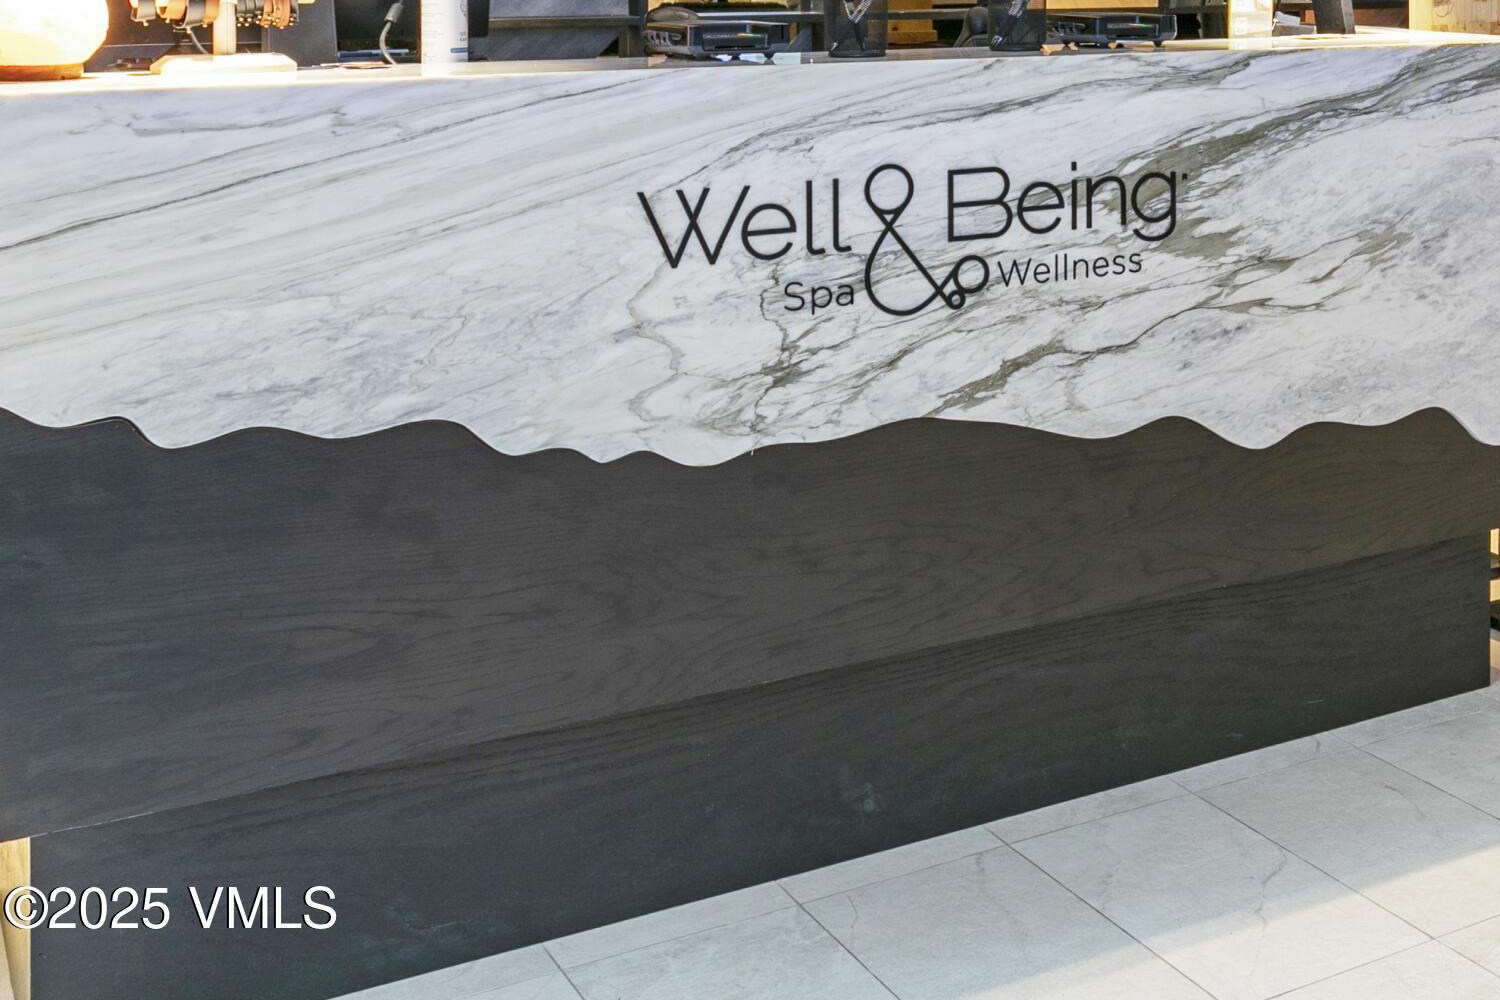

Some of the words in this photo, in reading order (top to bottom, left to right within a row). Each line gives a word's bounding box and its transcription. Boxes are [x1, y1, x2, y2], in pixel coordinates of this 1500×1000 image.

[636, 178, 853, 270] Well
[947, 161, 1178, 242] Being
[784, 280, 855, 315] Spa
[997, 253, 1142, 288] Wellness
